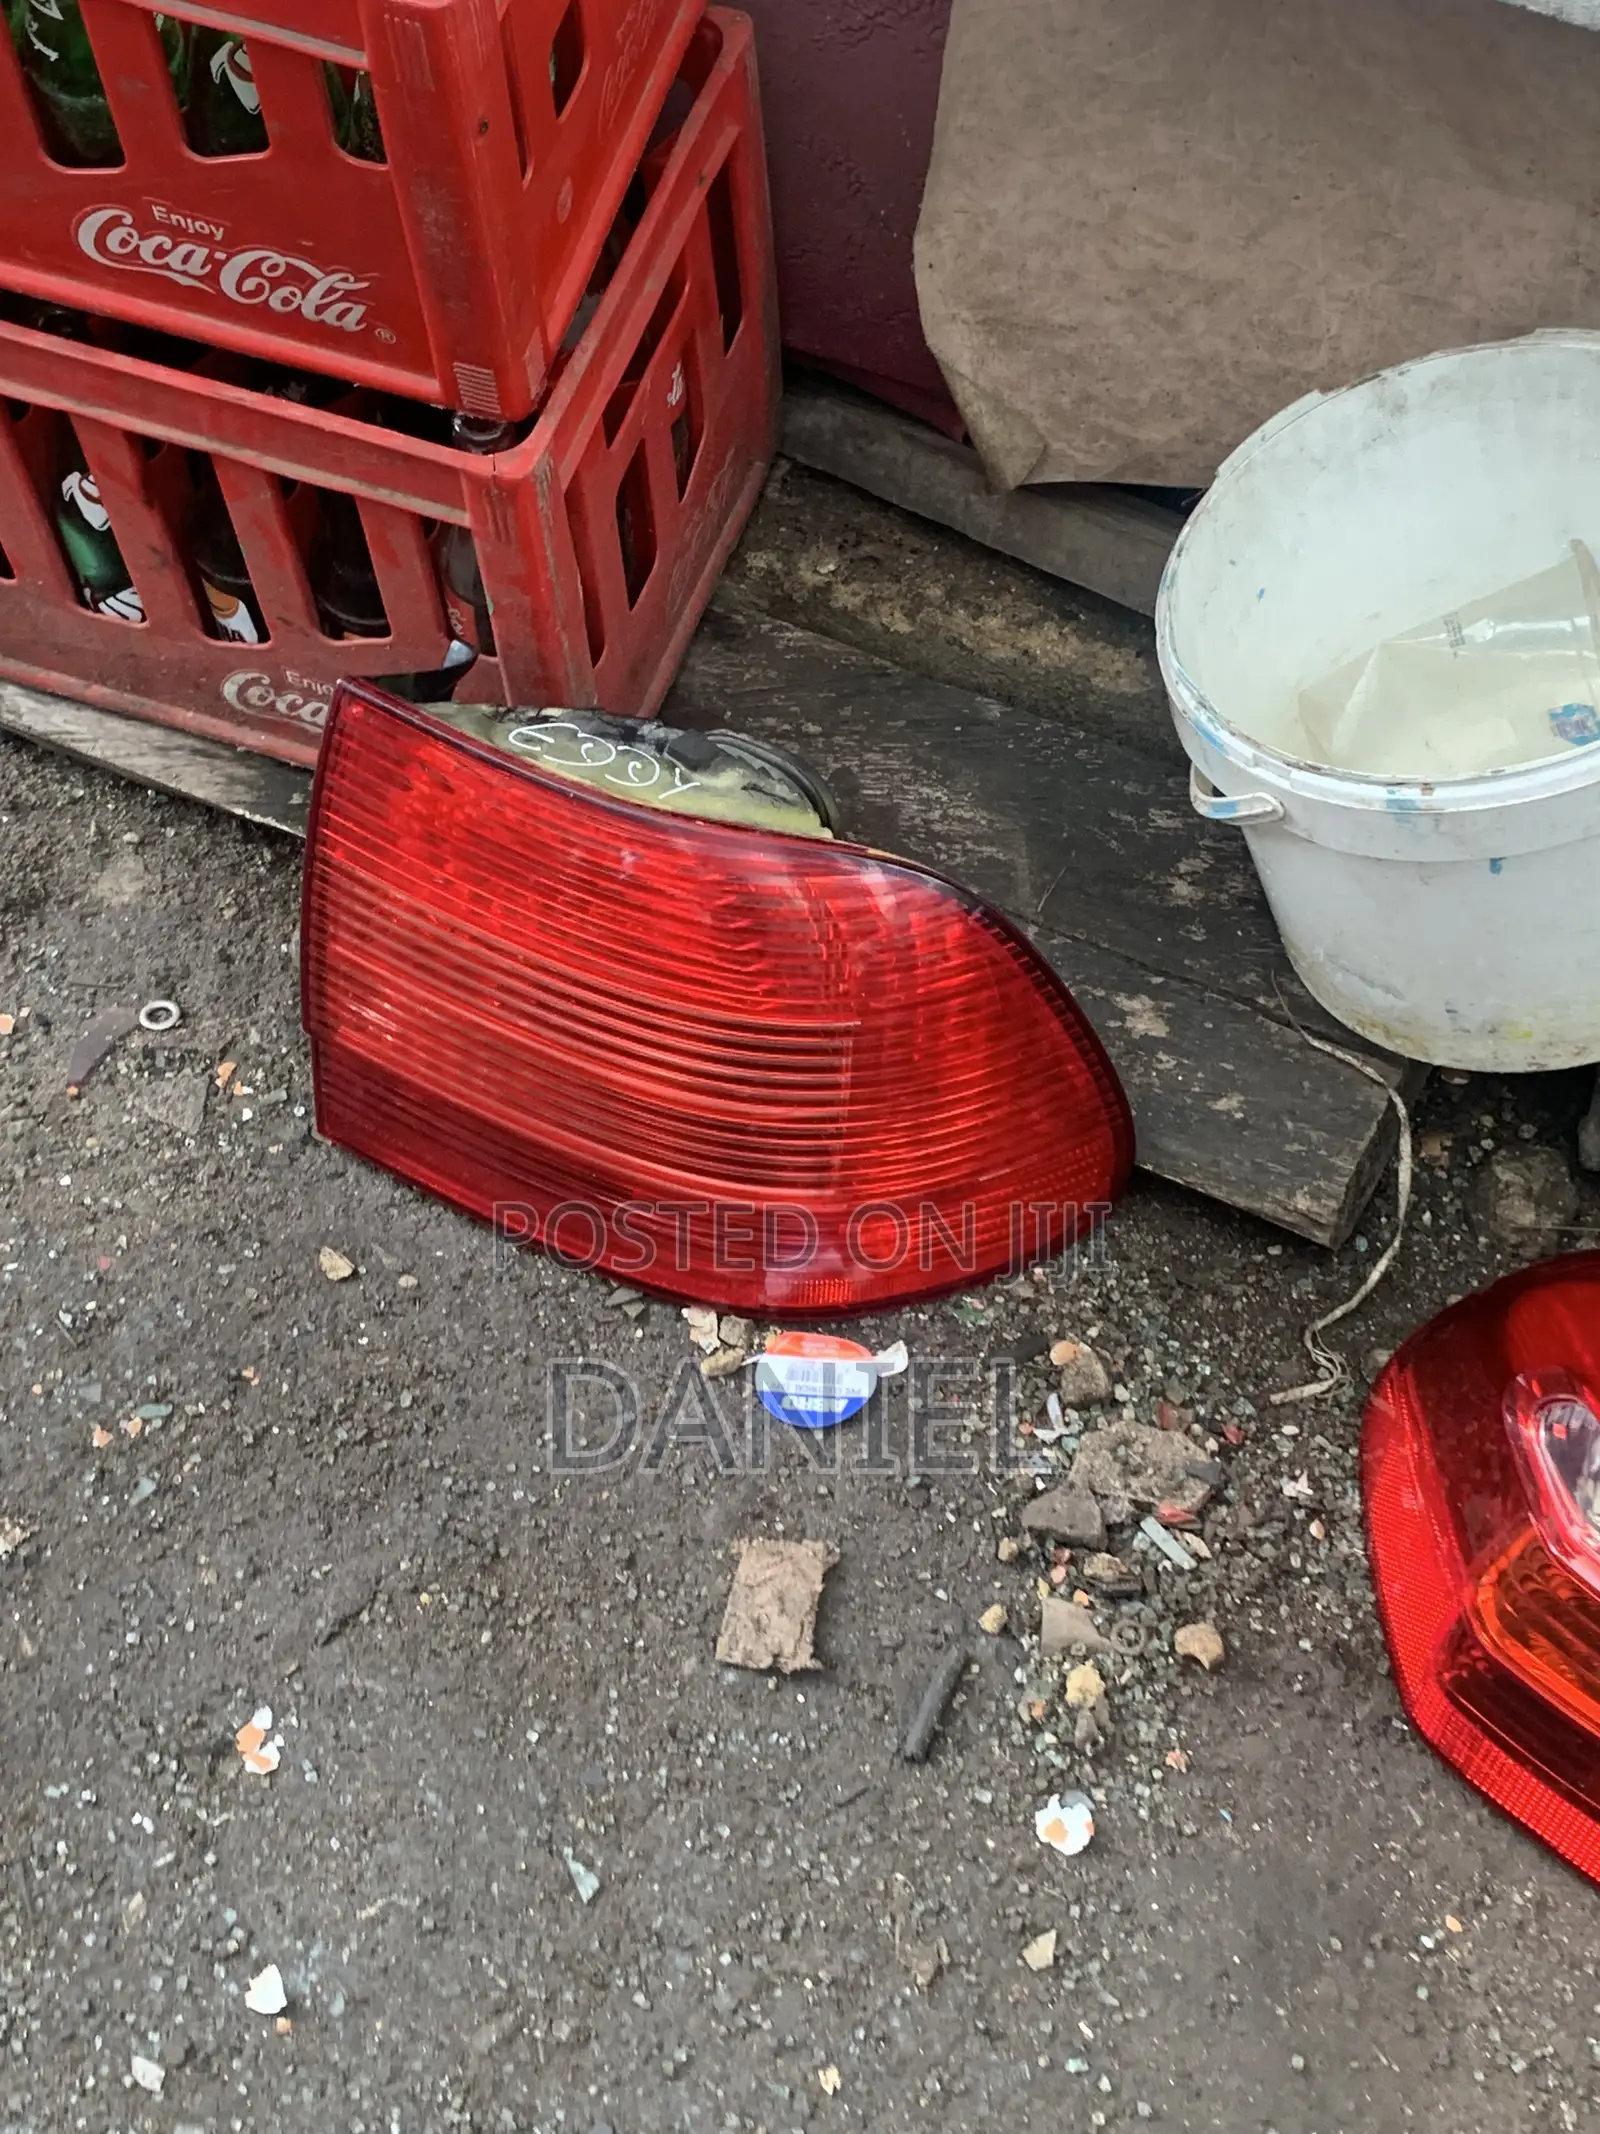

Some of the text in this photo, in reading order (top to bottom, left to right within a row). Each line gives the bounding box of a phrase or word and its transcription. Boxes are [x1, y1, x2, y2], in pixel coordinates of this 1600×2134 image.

[151, 204, 225, 241] Enjoy
[77, 207, 371, 333] Coca-Cola
[222, 671, 330, 734] Coca
[285, 669, 334, 696] Enjo
